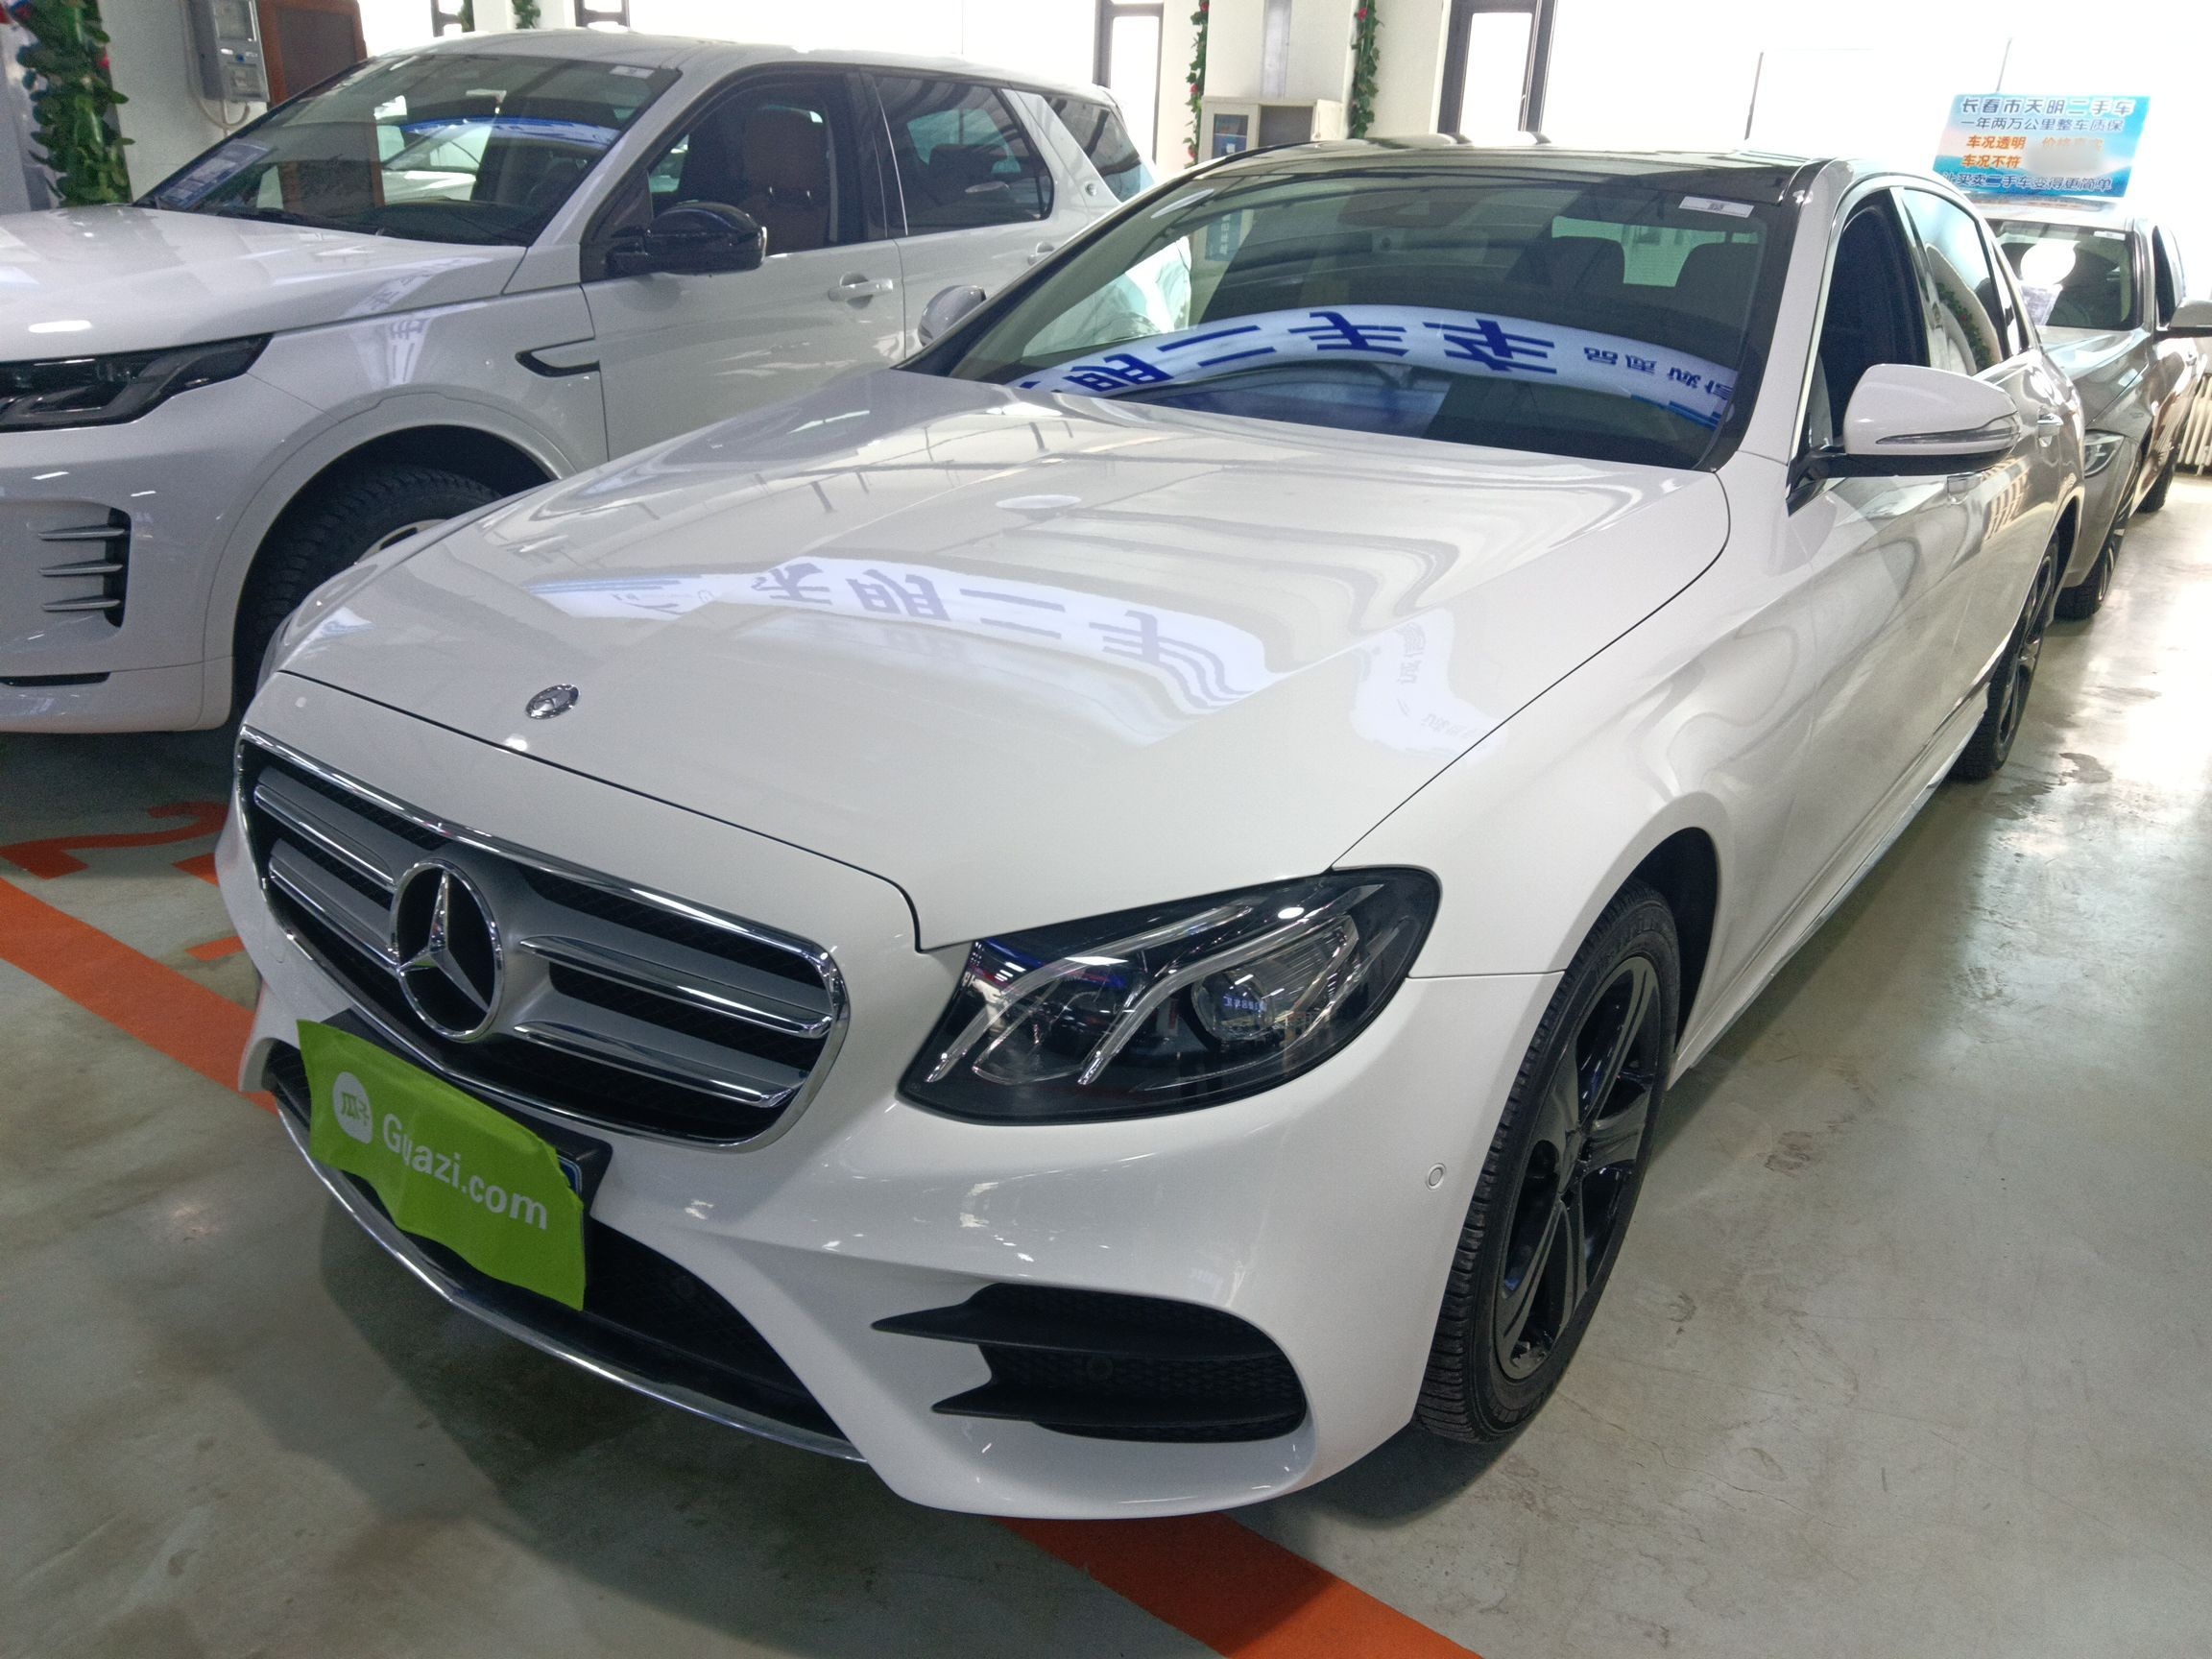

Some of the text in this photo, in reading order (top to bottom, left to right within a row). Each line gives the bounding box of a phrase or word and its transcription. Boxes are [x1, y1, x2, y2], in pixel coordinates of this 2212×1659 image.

[1961, 98, 2134, 116] 长春市天明二手车
[1960, 117, 2124, 132] 一年两万公里整车质保
[1966, 135, 2026, 150] 车况透明
[1961, 154, 2021, 169] 车况不符
[383, 1113, 548, 1230] Guazi.com
